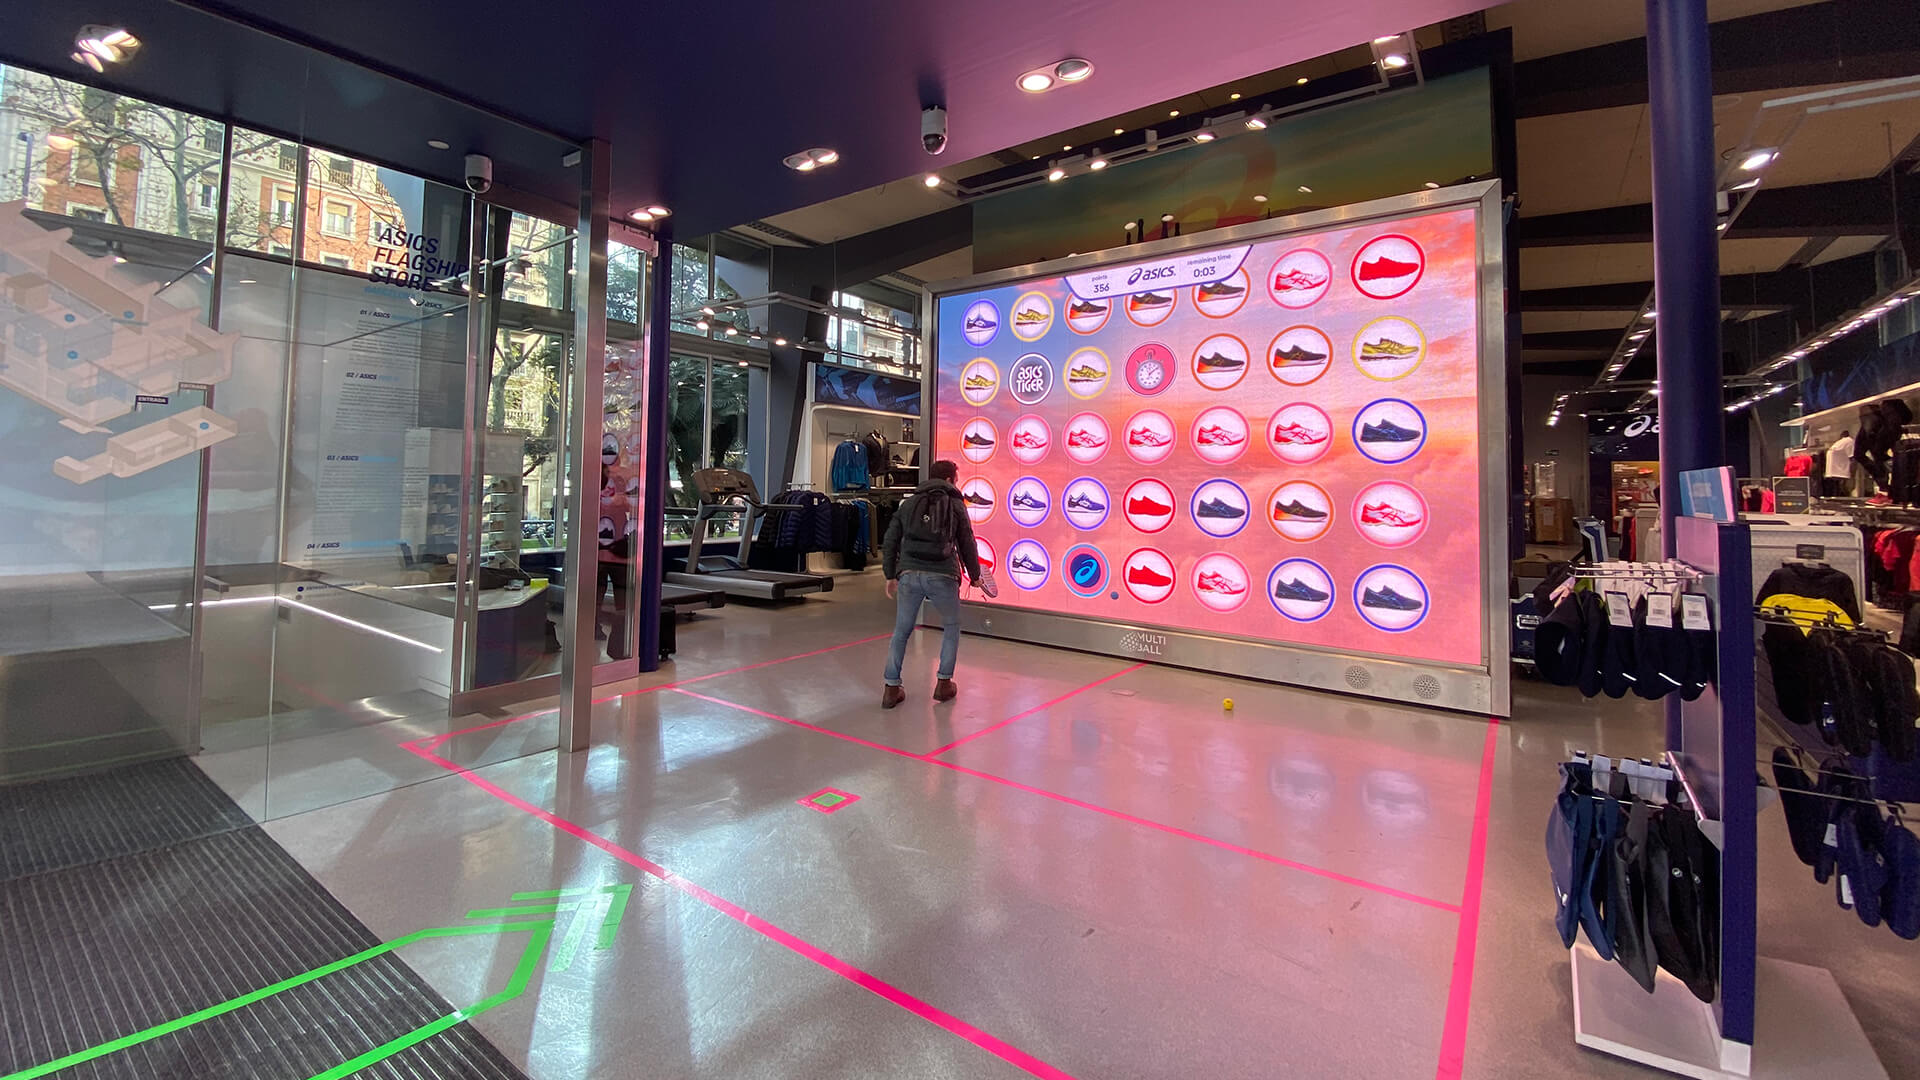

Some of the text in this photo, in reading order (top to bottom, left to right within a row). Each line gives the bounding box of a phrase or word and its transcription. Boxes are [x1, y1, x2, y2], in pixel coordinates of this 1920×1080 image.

[378, 228, 438, 253] ASICS
[373, 247, 469, 277] FLAGSHIP
[1187, 253, 1232, 266] remaining time
[1091, 274, 1108, 282] points
[1193, 266, 1216, 278] 0:03
[368, 266, 433, 292] STORE
[1093, 283, 1110, 293] 356
